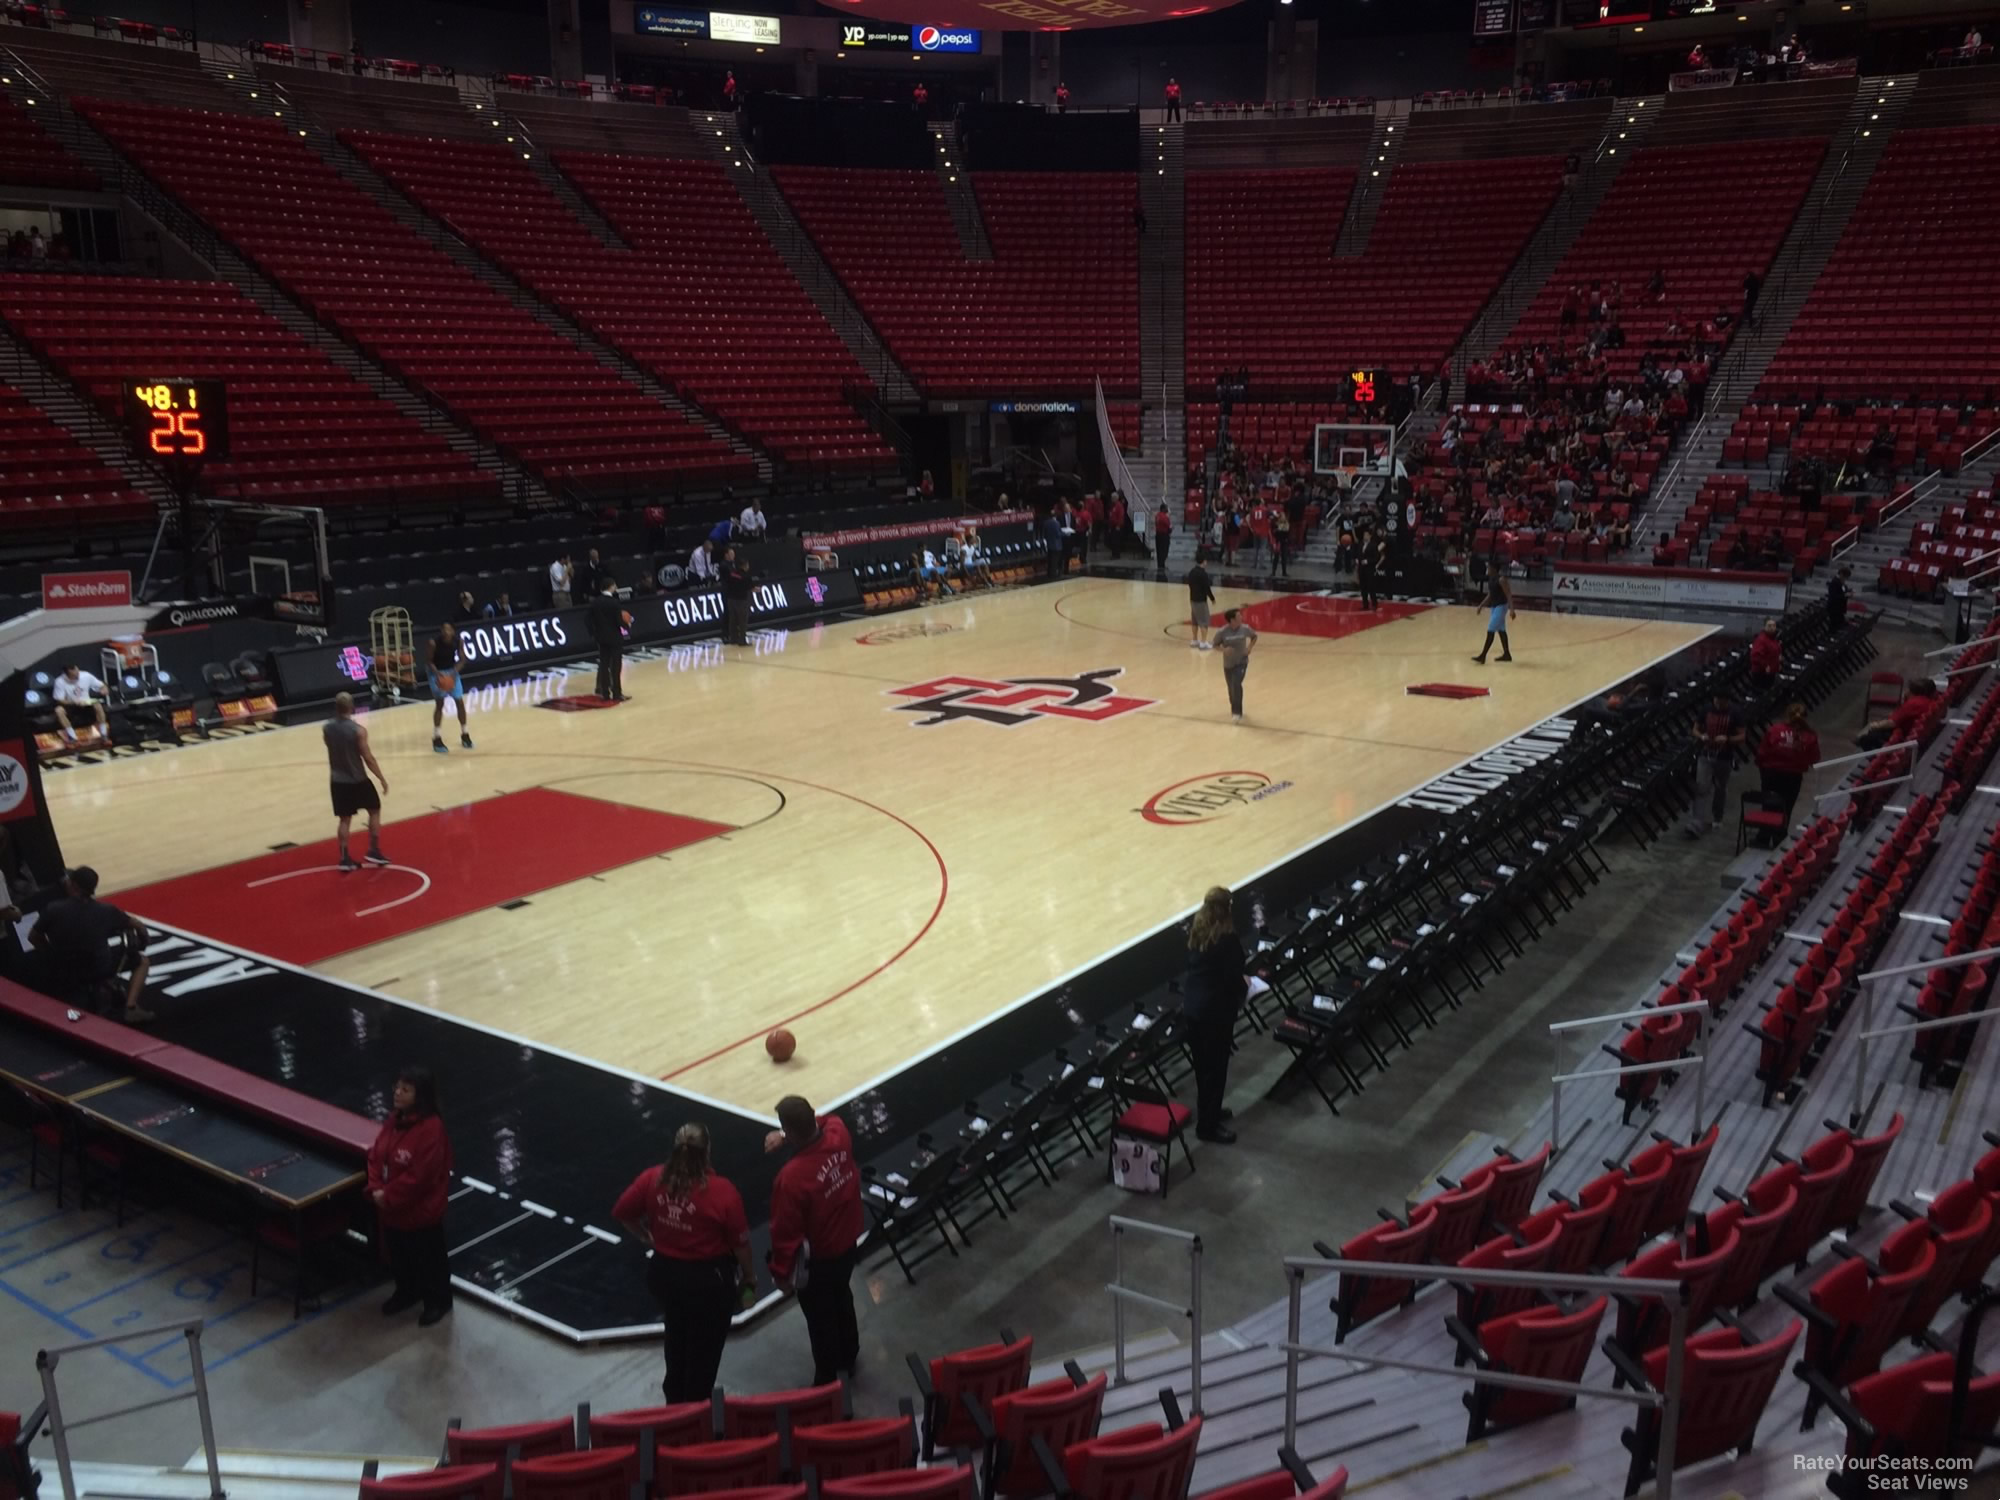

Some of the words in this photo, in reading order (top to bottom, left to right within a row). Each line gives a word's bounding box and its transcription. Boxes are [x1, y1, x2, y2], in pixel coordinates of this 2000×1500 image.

[754, 18, 768, 28] NOW
[754, 28, 778, 38] LEASING
[844, 25, 865, 42] yp
[940, 33, 973, 46] pepsi
[136, 385, 197, 411] 48.1
[1354, 382, 1375, 402] 25
[151, 412, 205, 455] 25
[813, 536, 837, 546] TOYOTA
[846, 532, 869, 543] TOYOTA
[878, 528, 900, 539] TOYOTA
[1582, 578, 1625, 589] Associated
[1626, 582, 1661, 592] Students
[170, 604, 238, 628] QUALCOMM
[460, 616, 567, 661] GOAZTECS
[1130, 776, 1267, 817] VIEJAS
[817, 1151, 848, 1183] ELITE
